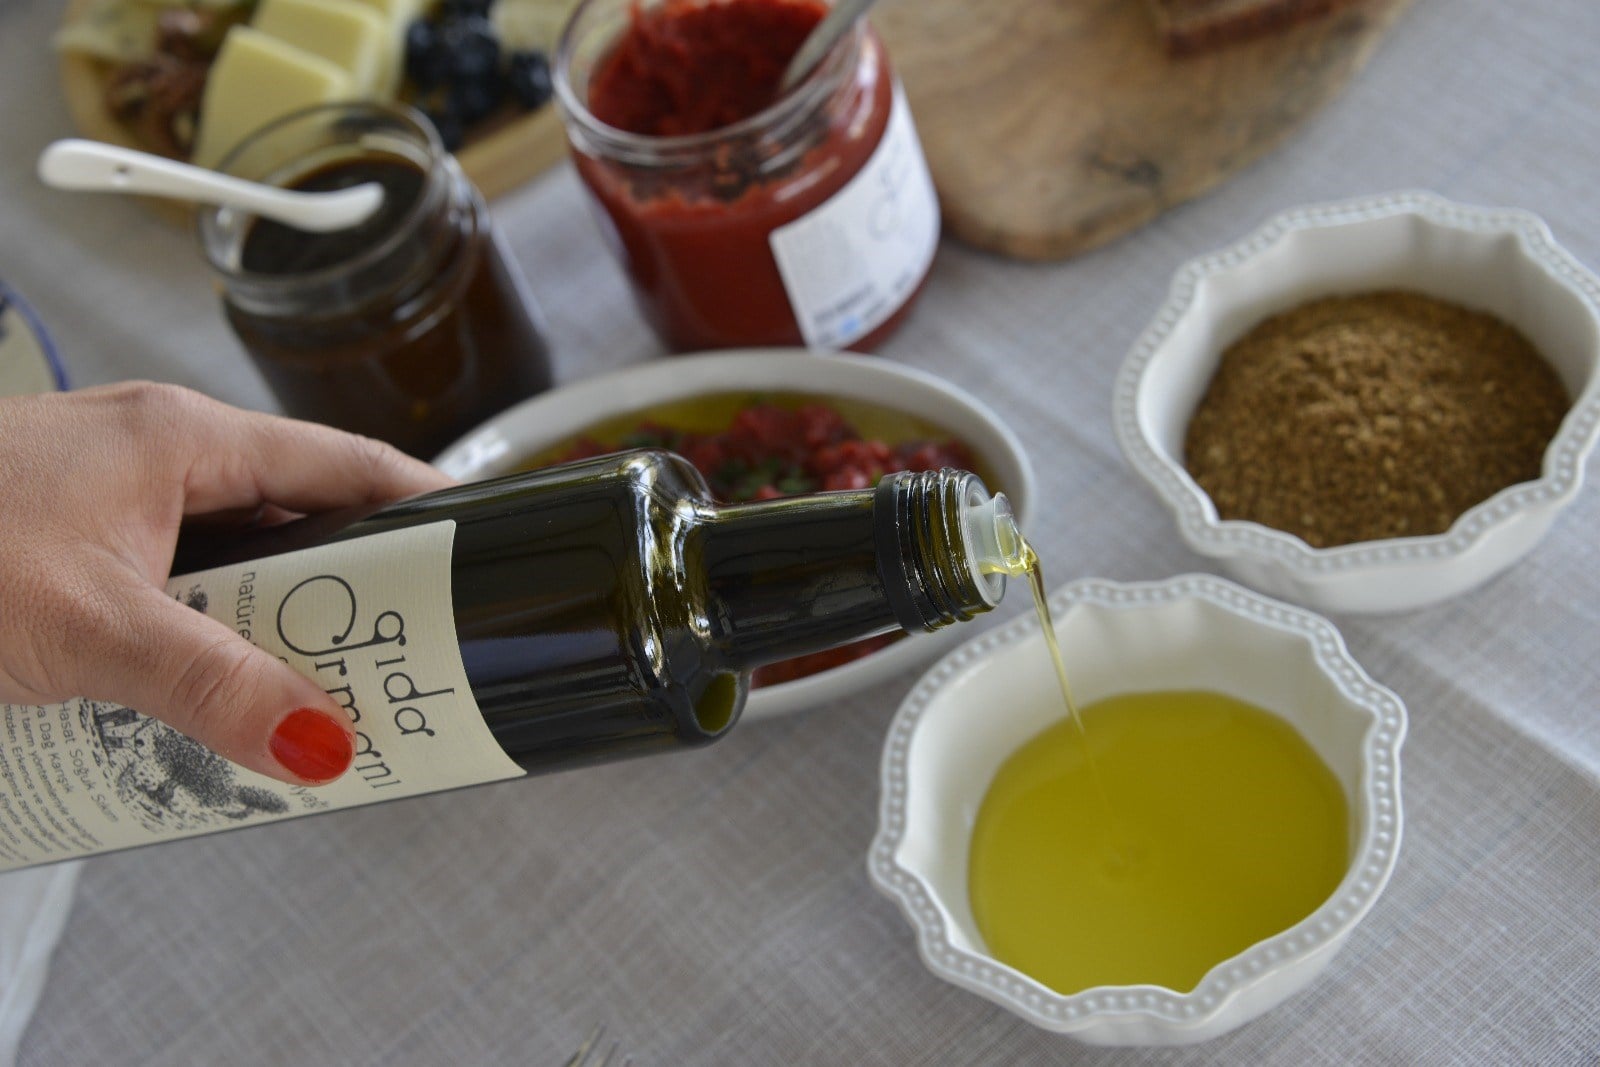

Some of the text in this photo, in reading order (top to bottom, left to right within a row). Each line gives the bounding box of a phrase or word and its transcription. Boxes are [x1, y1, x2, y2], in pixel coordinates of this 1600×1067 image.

[235, 571, 257, 647] natüre
[39, 722, 56, 750] Dağ
[70, 749, 97, 790] Soğuk
